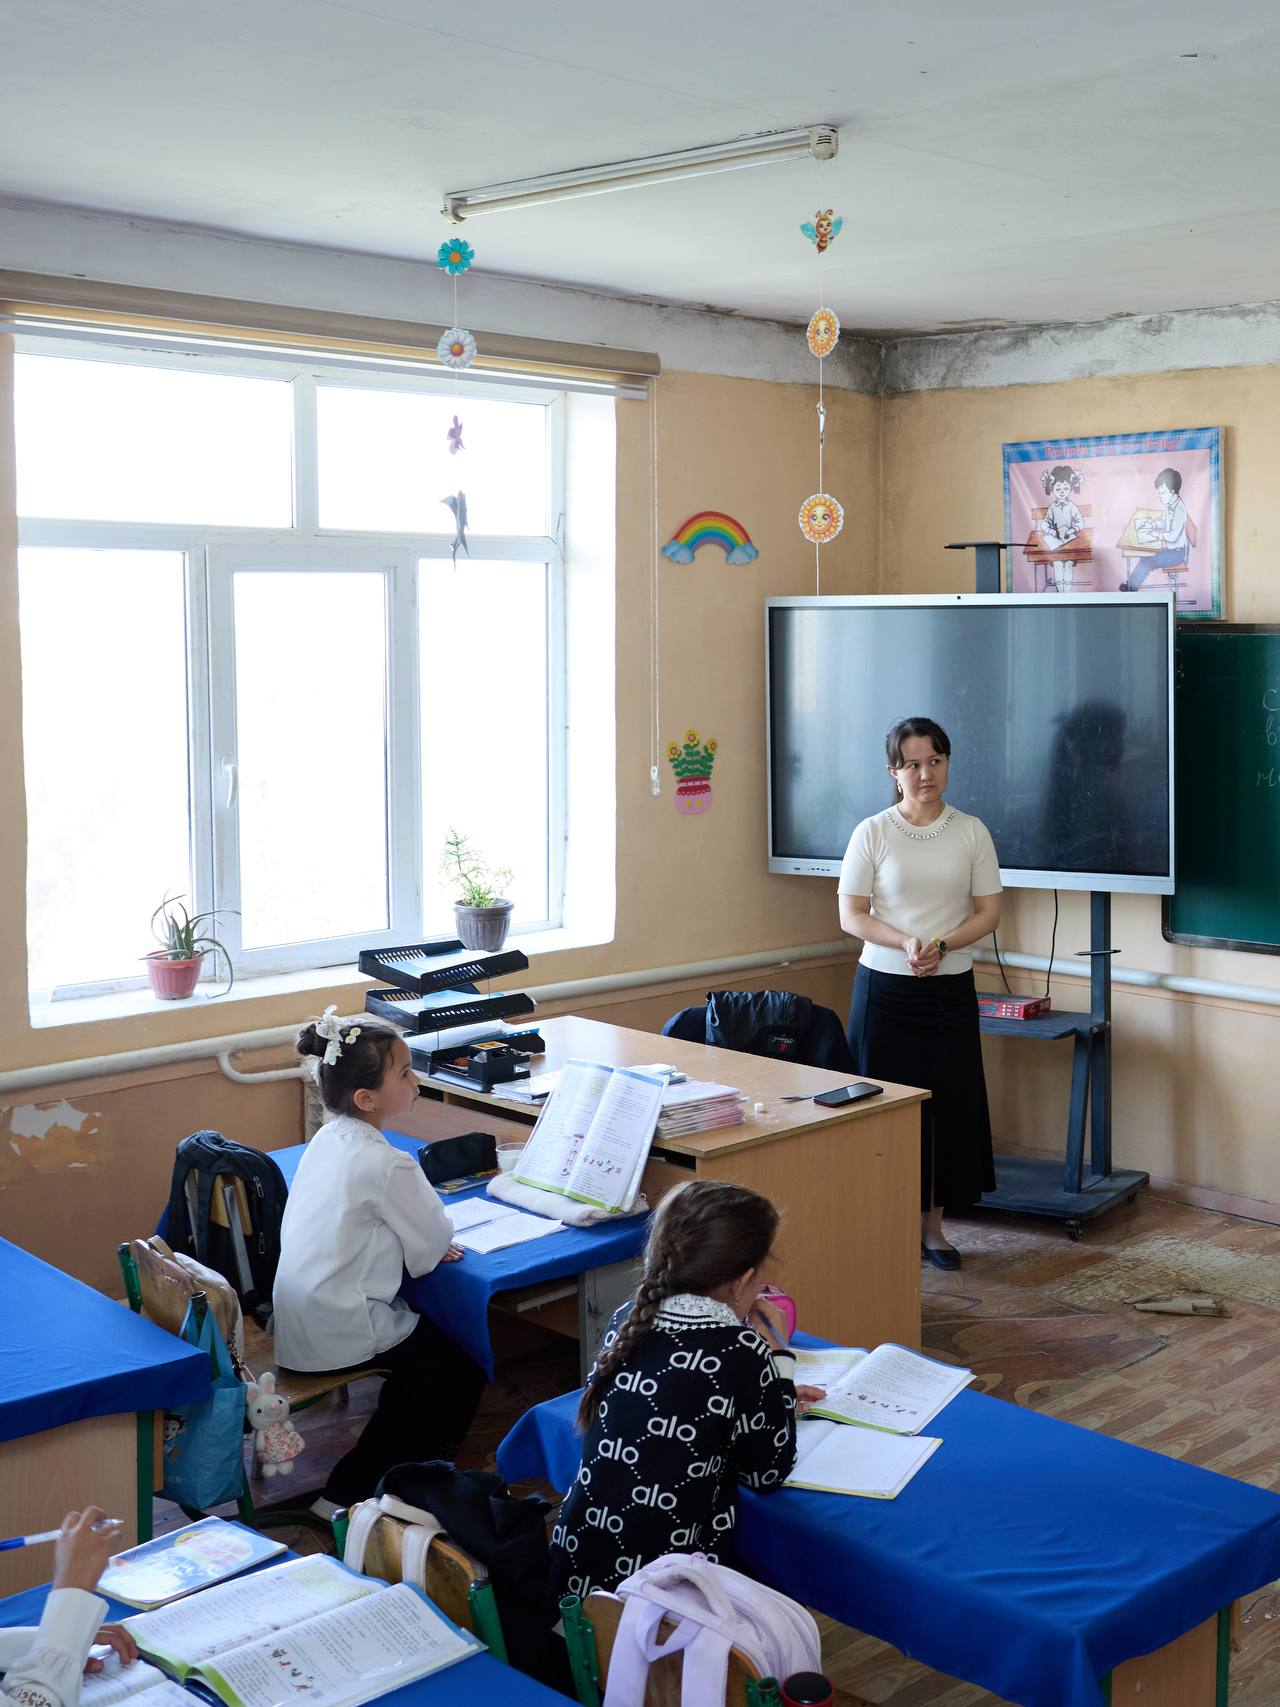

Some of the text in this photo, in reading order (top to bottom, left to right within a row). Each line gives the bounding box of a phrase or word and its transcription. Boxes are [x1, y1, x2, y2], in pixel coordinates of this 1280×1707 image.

[669, 1349, 721, 1374] alo
[615, 1370, 658, 1396] alo
[647, 1416, 696, 1442] alo
[598, 1438, 639, 1465] alo
[632, 1484, 677, 1511] alo
[586, 1506, 623, 1533] alo
[552, 1525, 578, 1552] alo
